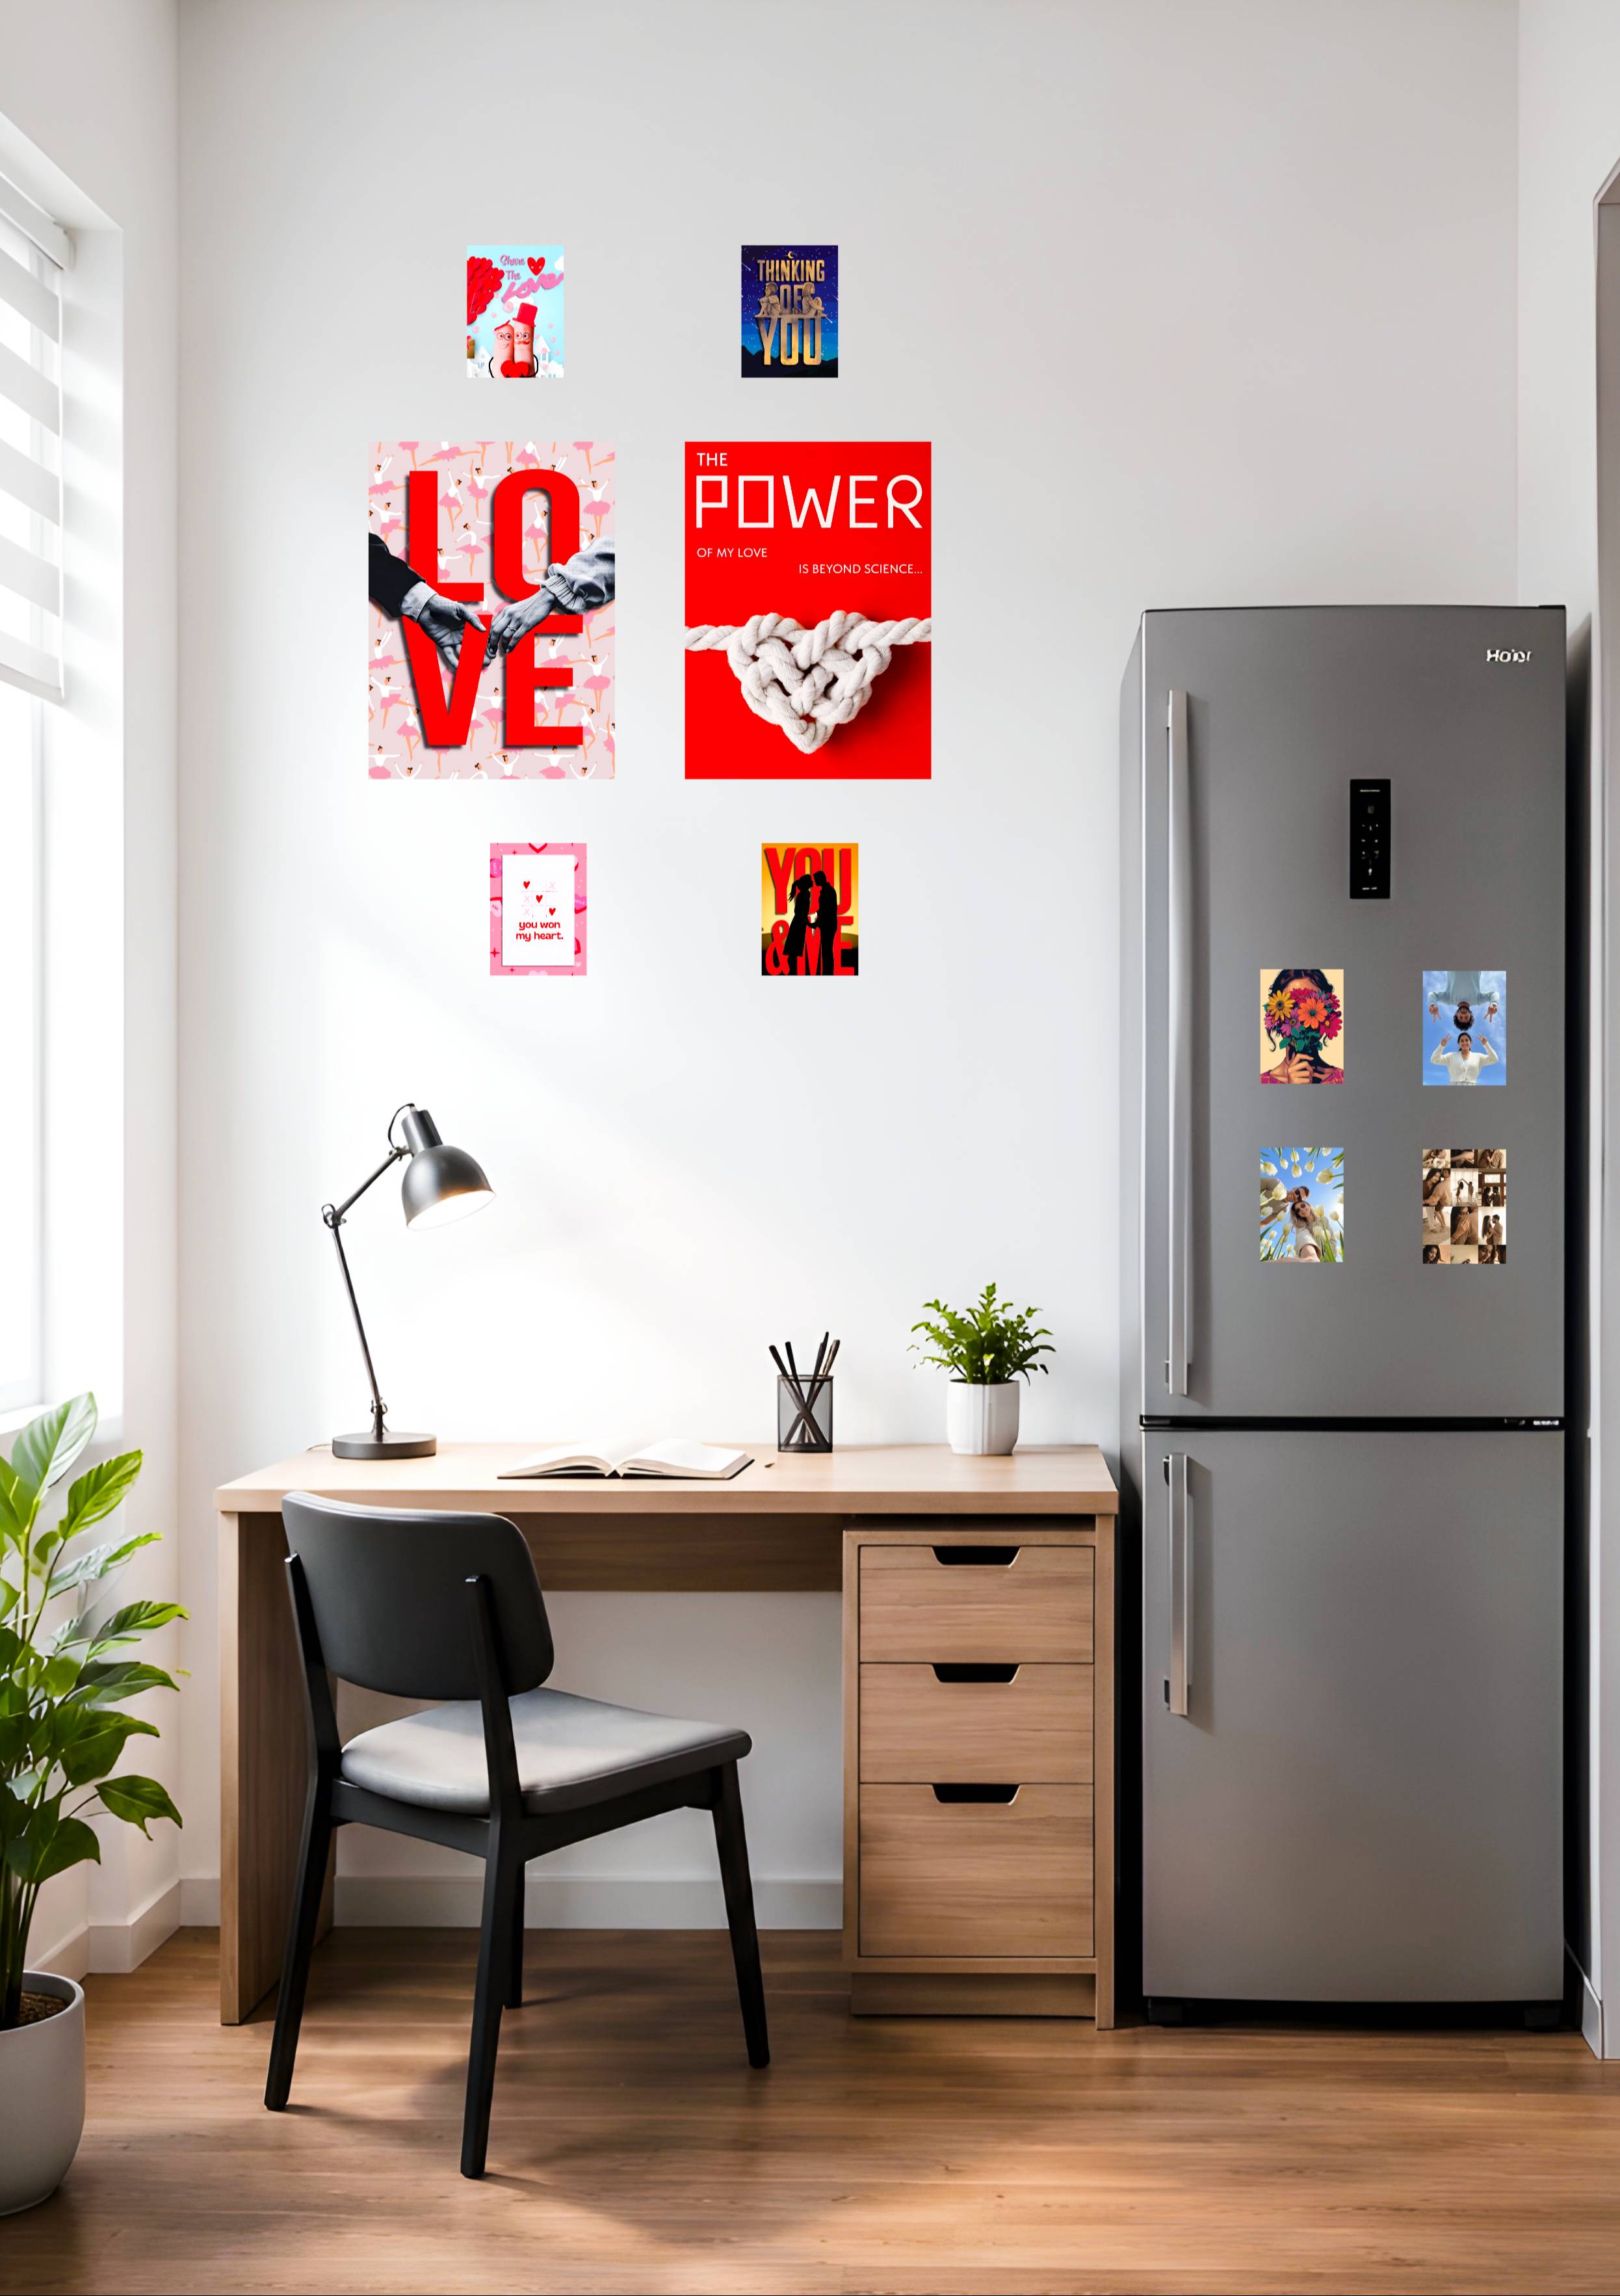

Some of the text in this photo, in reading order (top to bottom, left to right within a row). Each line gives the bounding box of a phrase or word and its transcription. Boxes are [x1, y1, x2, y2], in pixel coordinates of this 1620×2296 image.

[504, 269, 521, 280] The
[757, 259, 825, 282] THINKING
[779, 284, 804, 315] OF
[757, 317, 822, 365] YOU
[696, 453, 728, 466] THE
[696, 474, 923, 529] POWER
[696, 548, 768, 558] OF MY LOVE
[799, 564, 923, 574] IS BEYOND SCIENCE...
[764, 847, 852, 916] YOU
[519, 921, 538, 931] you
[516, 931, 564, 942] my heart.
